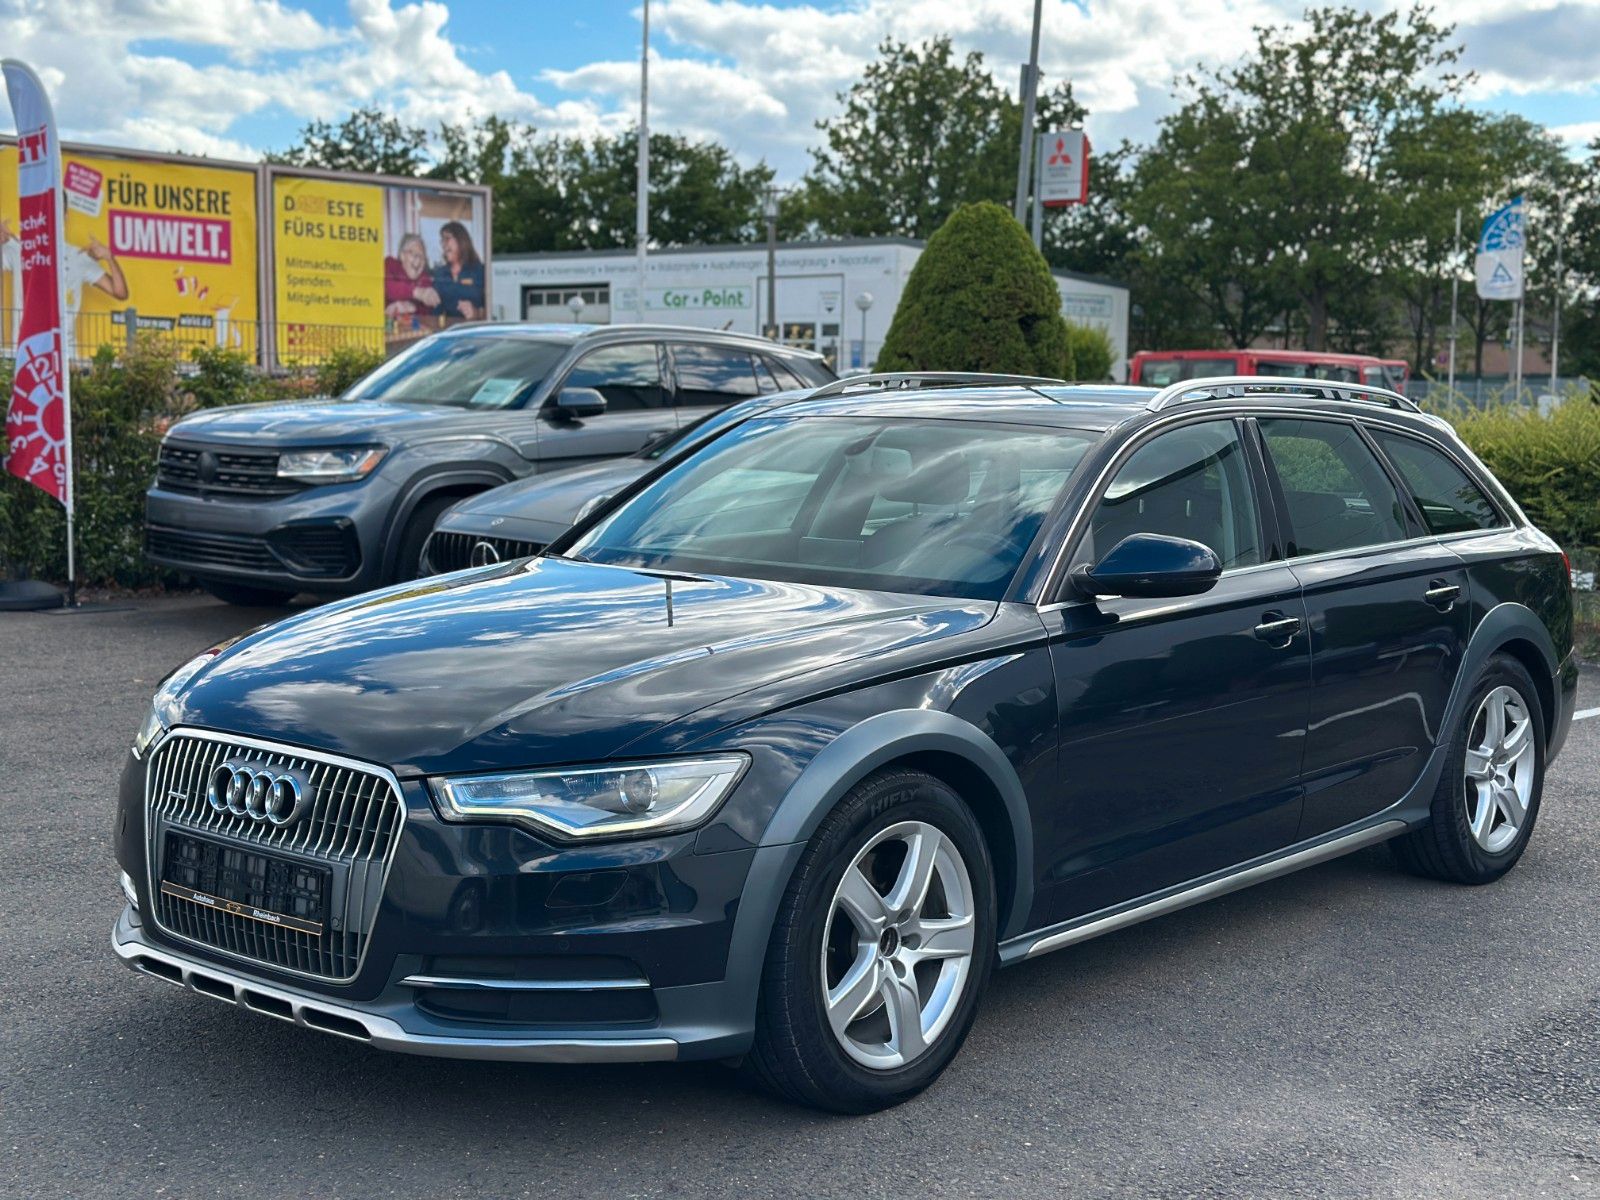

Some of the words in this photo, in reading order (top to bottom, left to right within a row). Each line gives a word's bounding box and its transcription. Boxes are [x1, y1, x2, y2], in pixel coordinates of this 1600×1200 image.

[107, 172, 147, 207] FÜR
[154, 183, 231, 215] UNSERE
[113, 215, 228, 259] UMWELT.
[284, 216, 325, 238] FÜRS
[329, 224, 379, 243] LEBEN
[286, 257, 347, 271] Mitmachen.
[287, 274, 334, 287] Spenden.
[287, 292, 330, 305] Mitglied
[332, 295, 373, 306] werden.
[663, 290, 688, 306] Car
[703, 289, 743, 306] Point
